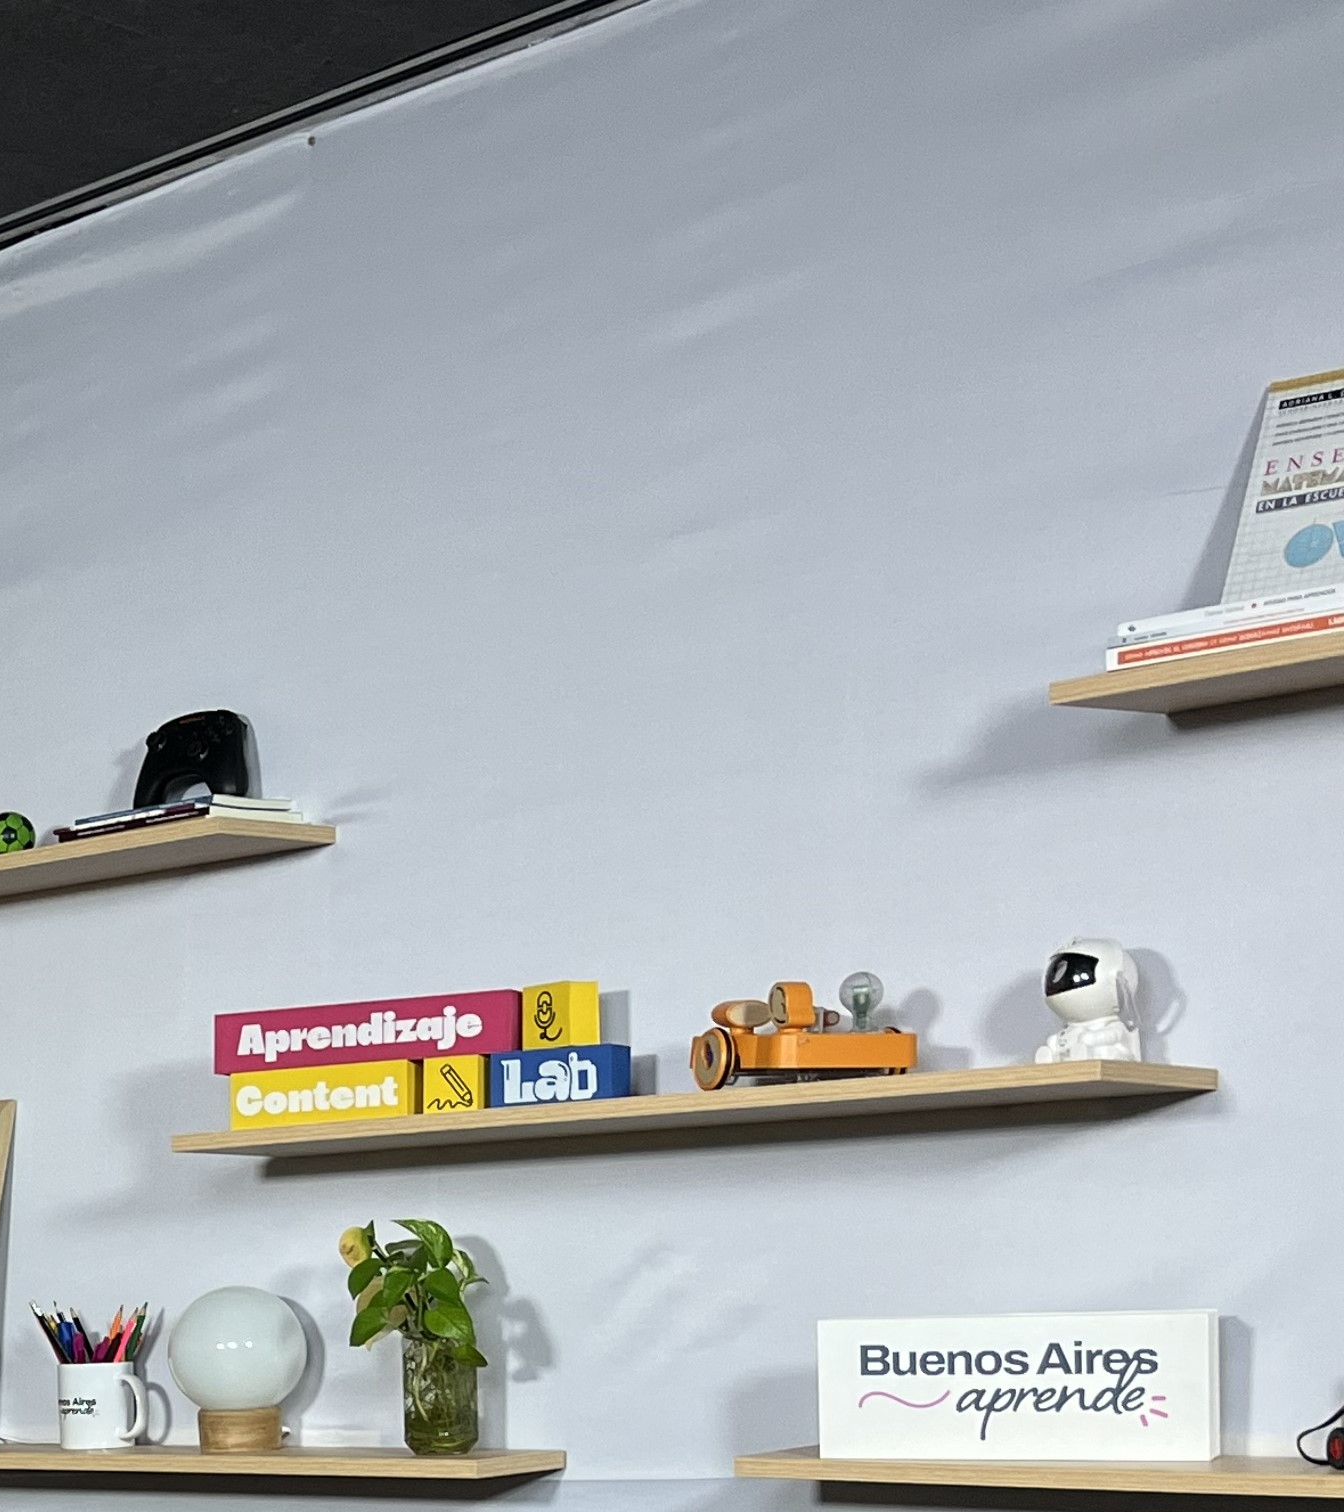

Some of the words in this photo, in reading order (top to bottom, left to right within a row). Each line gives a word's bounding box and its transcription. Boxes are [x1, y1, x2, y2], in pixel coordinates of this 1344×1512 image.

[1258, 500, 1276, 511] EN
[1282, 496, 1298, 507] LA
[237, 1006, 483, 1062] Aprendizaje
[235, 1076, 399, 1117] Content
[501, 1052, 598, 1105] Lab
[860, 1343, 1029, 1376] Buenos
[1036, 1340, 1159, 1376] Aires
[955, 1357, 1145, 1441] aprende
